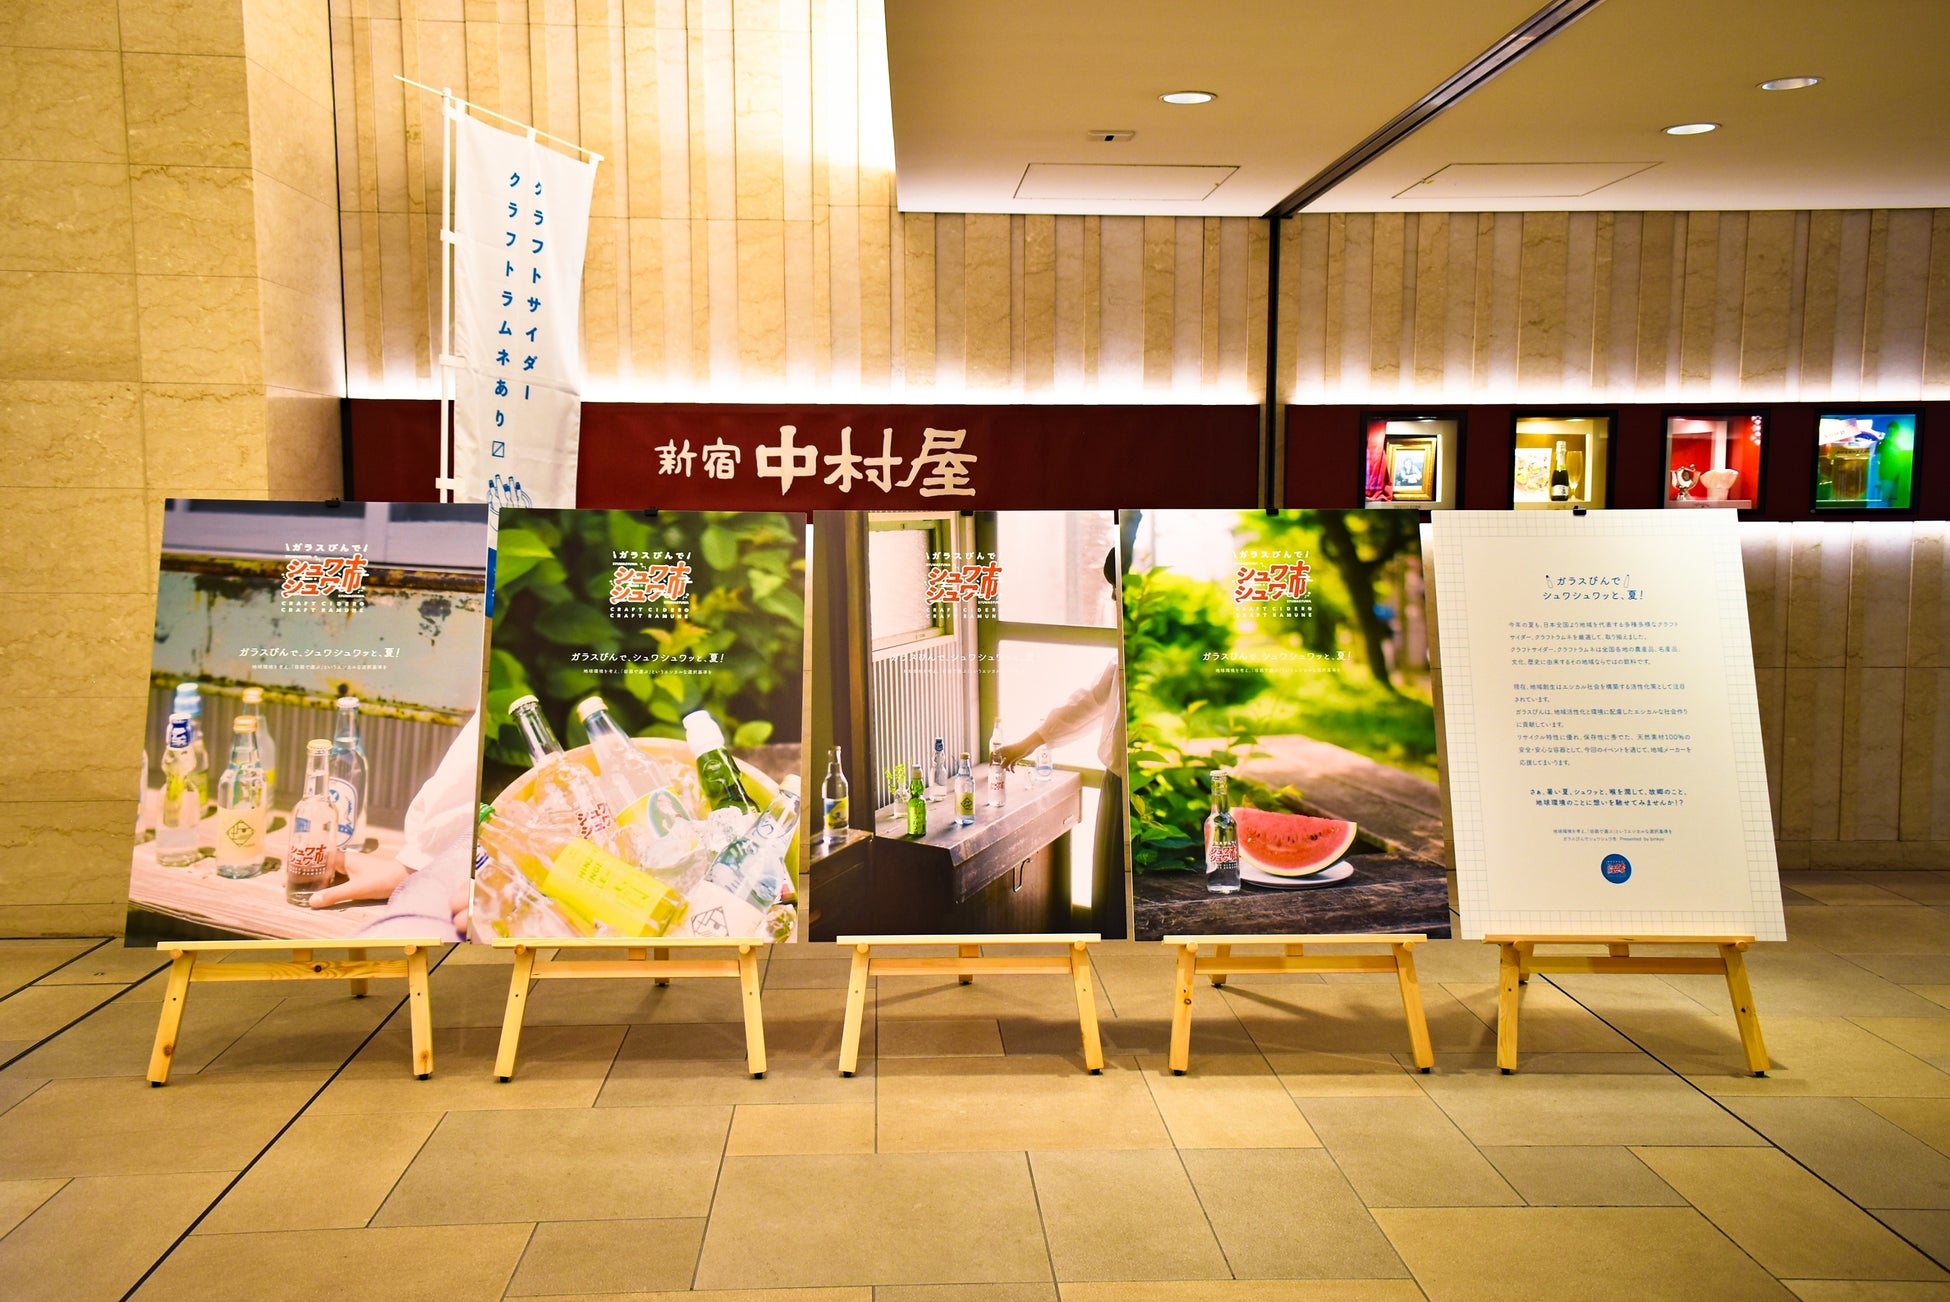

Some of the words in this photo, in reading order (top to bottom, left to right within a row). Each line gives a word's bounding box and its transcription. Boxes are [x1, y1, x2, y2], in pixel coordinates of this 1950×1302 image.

[619, 551, 685, 559] ガラスびんで
[1557, 576, 1621, 586] ガラスびんで
[1543, 589, 1643, 600] シュワシュワッと、夏!
[571, 652, 725, 663] ガラスびんで、シュワシュワッと、夏!
